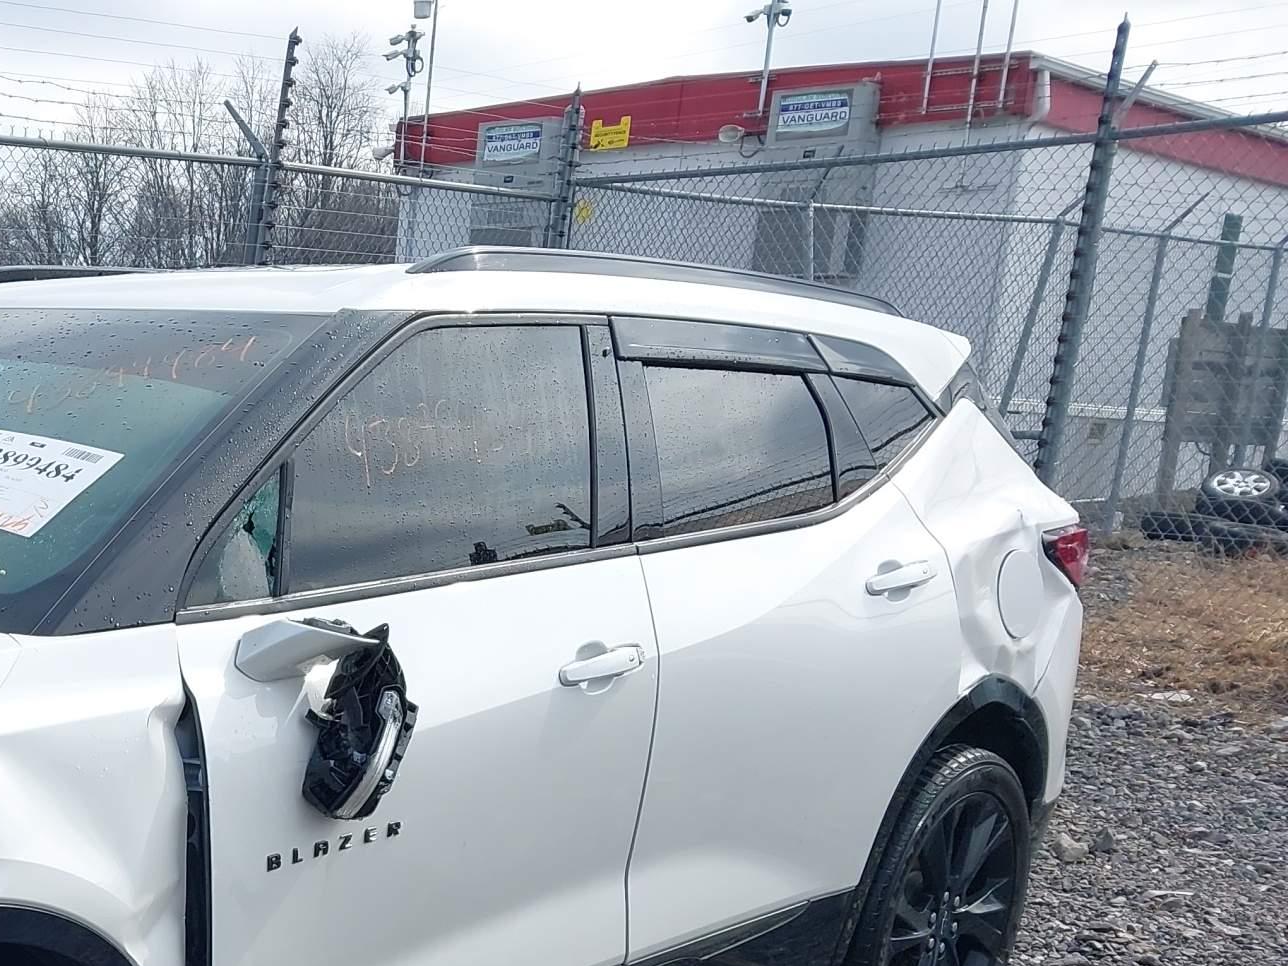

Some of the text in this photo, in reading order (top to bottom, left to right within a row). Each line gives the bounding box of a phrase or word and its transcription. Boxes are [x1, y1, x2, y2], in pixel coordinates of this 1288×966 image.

[782, 111, 848, 124] VANGUARD
[487, 141, 539, 153] VANGUARD
[266, 821, 402, 872] BLAZER
